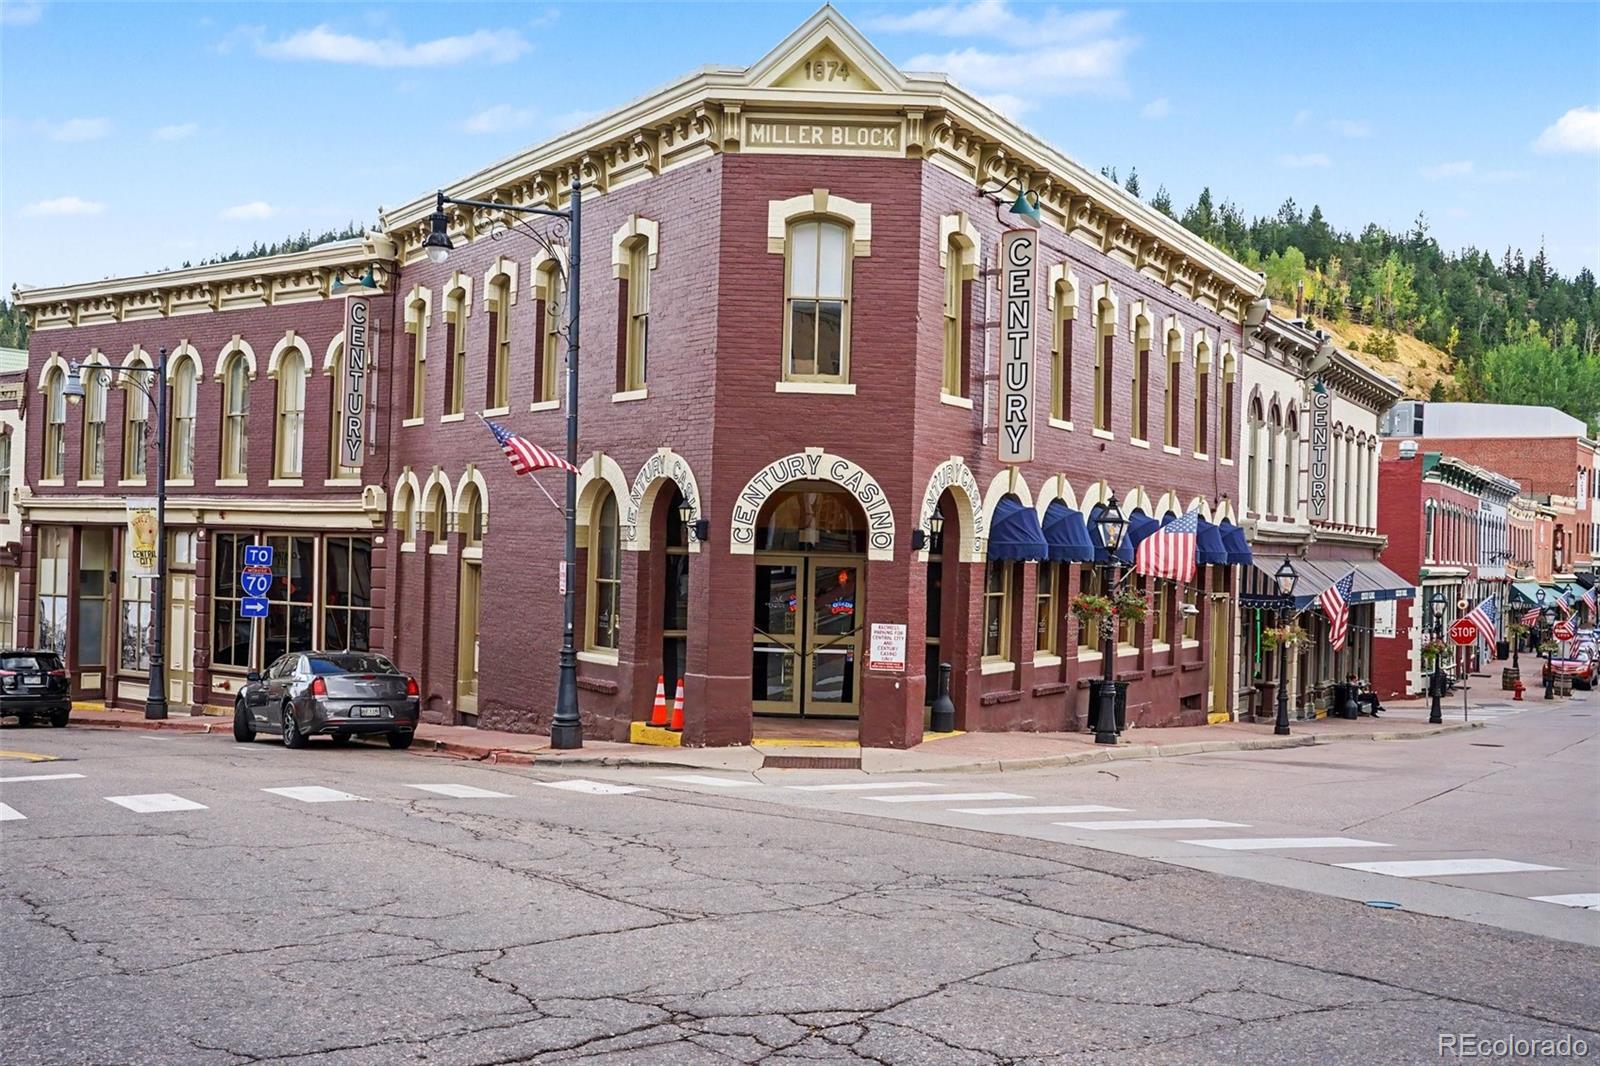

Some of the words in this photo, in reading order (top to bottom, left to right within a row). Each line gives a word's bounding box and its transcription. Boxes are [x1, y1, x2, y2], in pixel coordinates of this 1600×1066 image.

[804, 61, 850, 82] 1874
[751, 124, 824, 145] MILLER
[831, 126, 895, 146] BLOCK
[1005, 237, 1032, 454] CENTURY
[347, 302, 367, 461] CENTURY
[1311, 393, 1328, 515] CENTURY
[627, 454, 666, 540] CENTURY
[733, 454, 822, 543] CENTURY
[830, 460, 893, 549] CASINO
[132, 550, 157, 558] CENTRAL
[140, 557, 152, 565] CITY
[249, 549, 268, 562] TO
[246, 576, 267, 591] 70
[1451, 627, 1476, 638] STOP
